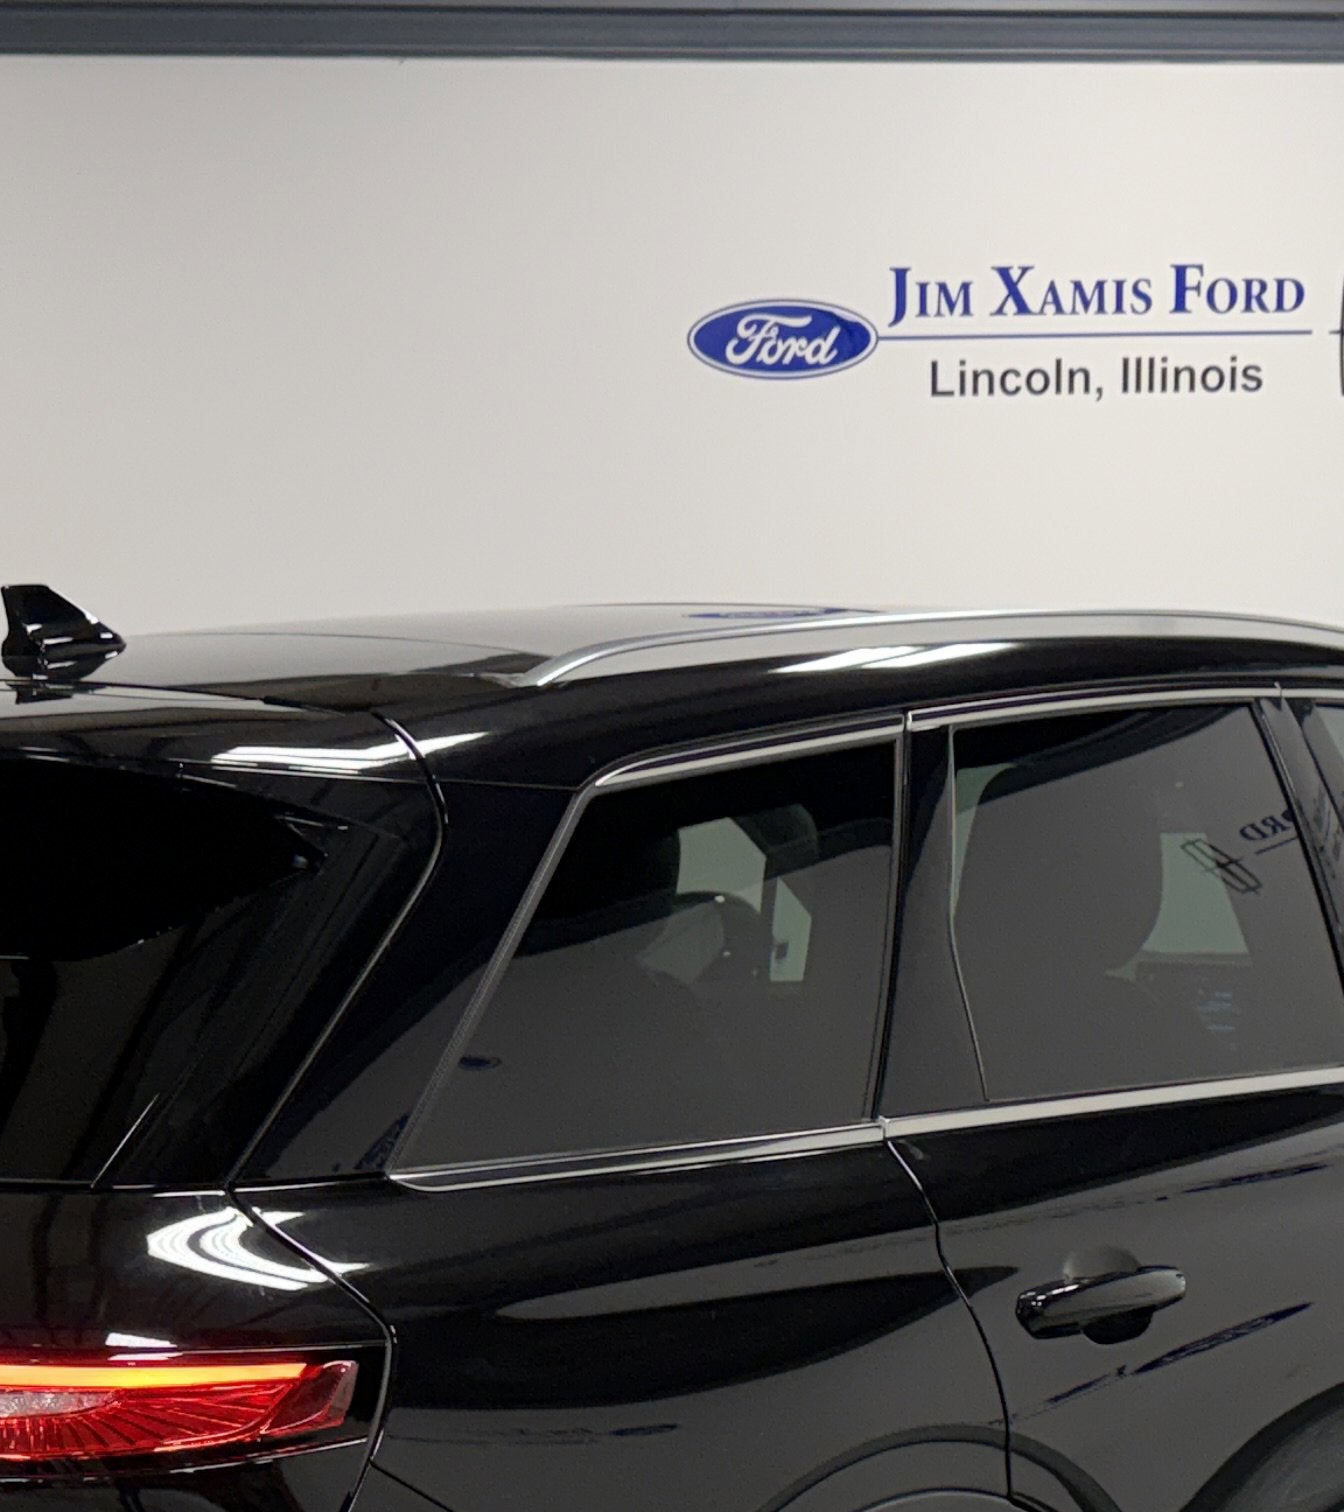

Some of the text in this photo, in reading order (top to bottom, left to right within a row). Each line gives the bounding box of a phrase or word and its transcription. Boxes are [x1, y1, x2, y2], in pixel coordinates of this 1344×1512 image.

[888, 263, 1306, 328] JIM XAMIS FORD
[725, 313, 841, 365] Ford
[930, 355, 1264, 401] Lincoln, Illinois
